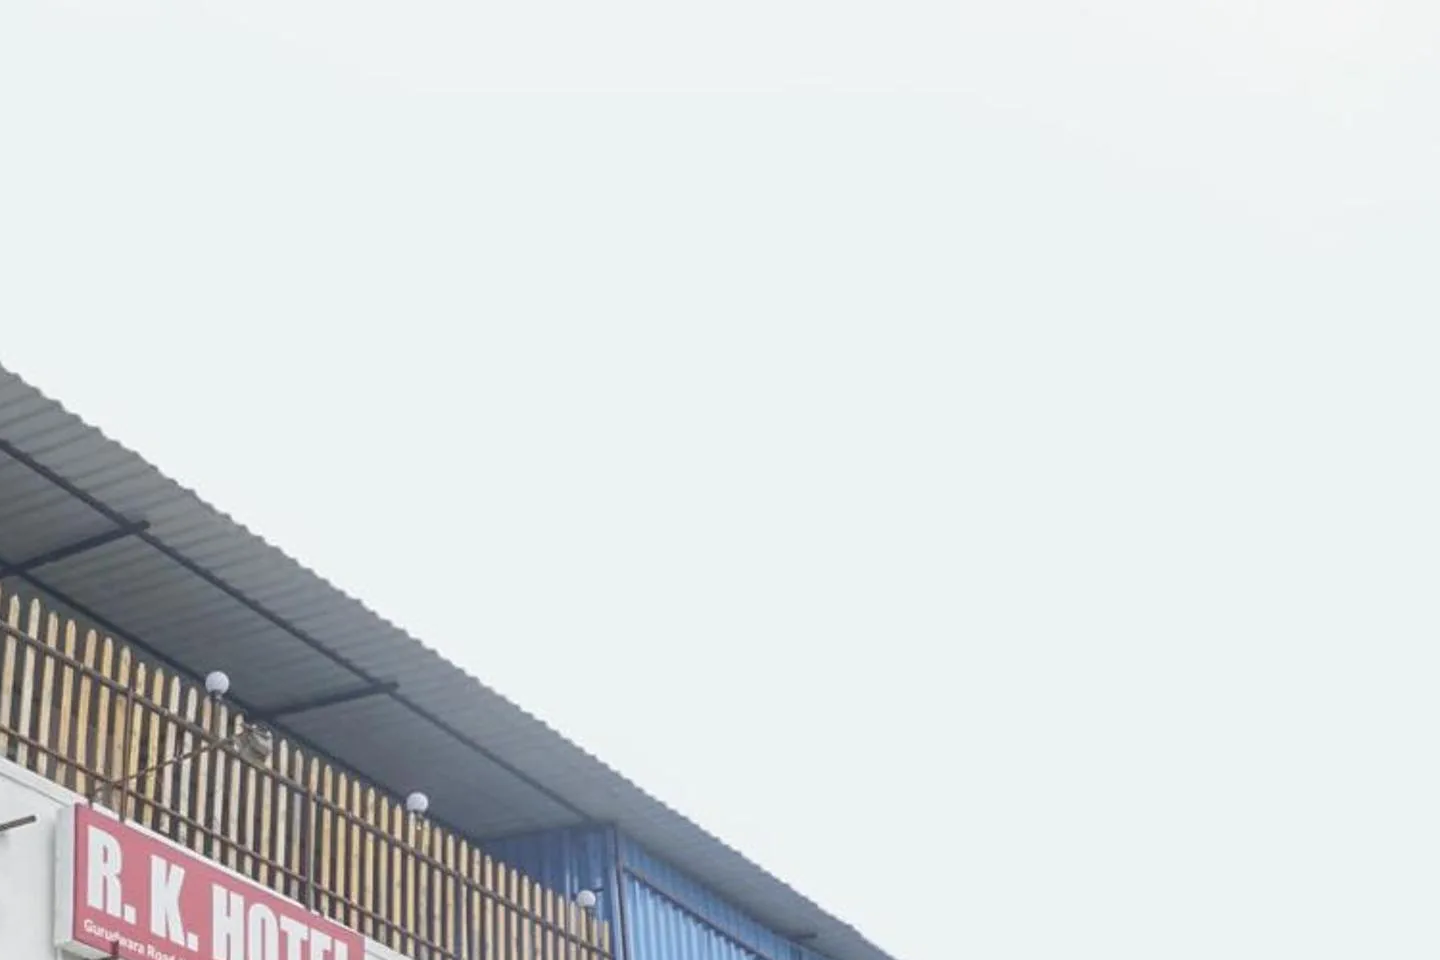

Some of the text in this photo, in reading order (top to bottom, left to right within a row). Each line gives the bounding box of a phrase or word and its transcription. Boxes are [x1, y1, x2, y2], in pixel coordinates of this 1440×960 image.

[87, 825, 137, 925] R.
[150, 854, 199, 952] K.
[83, 918, 145, 954] Gurudwara
